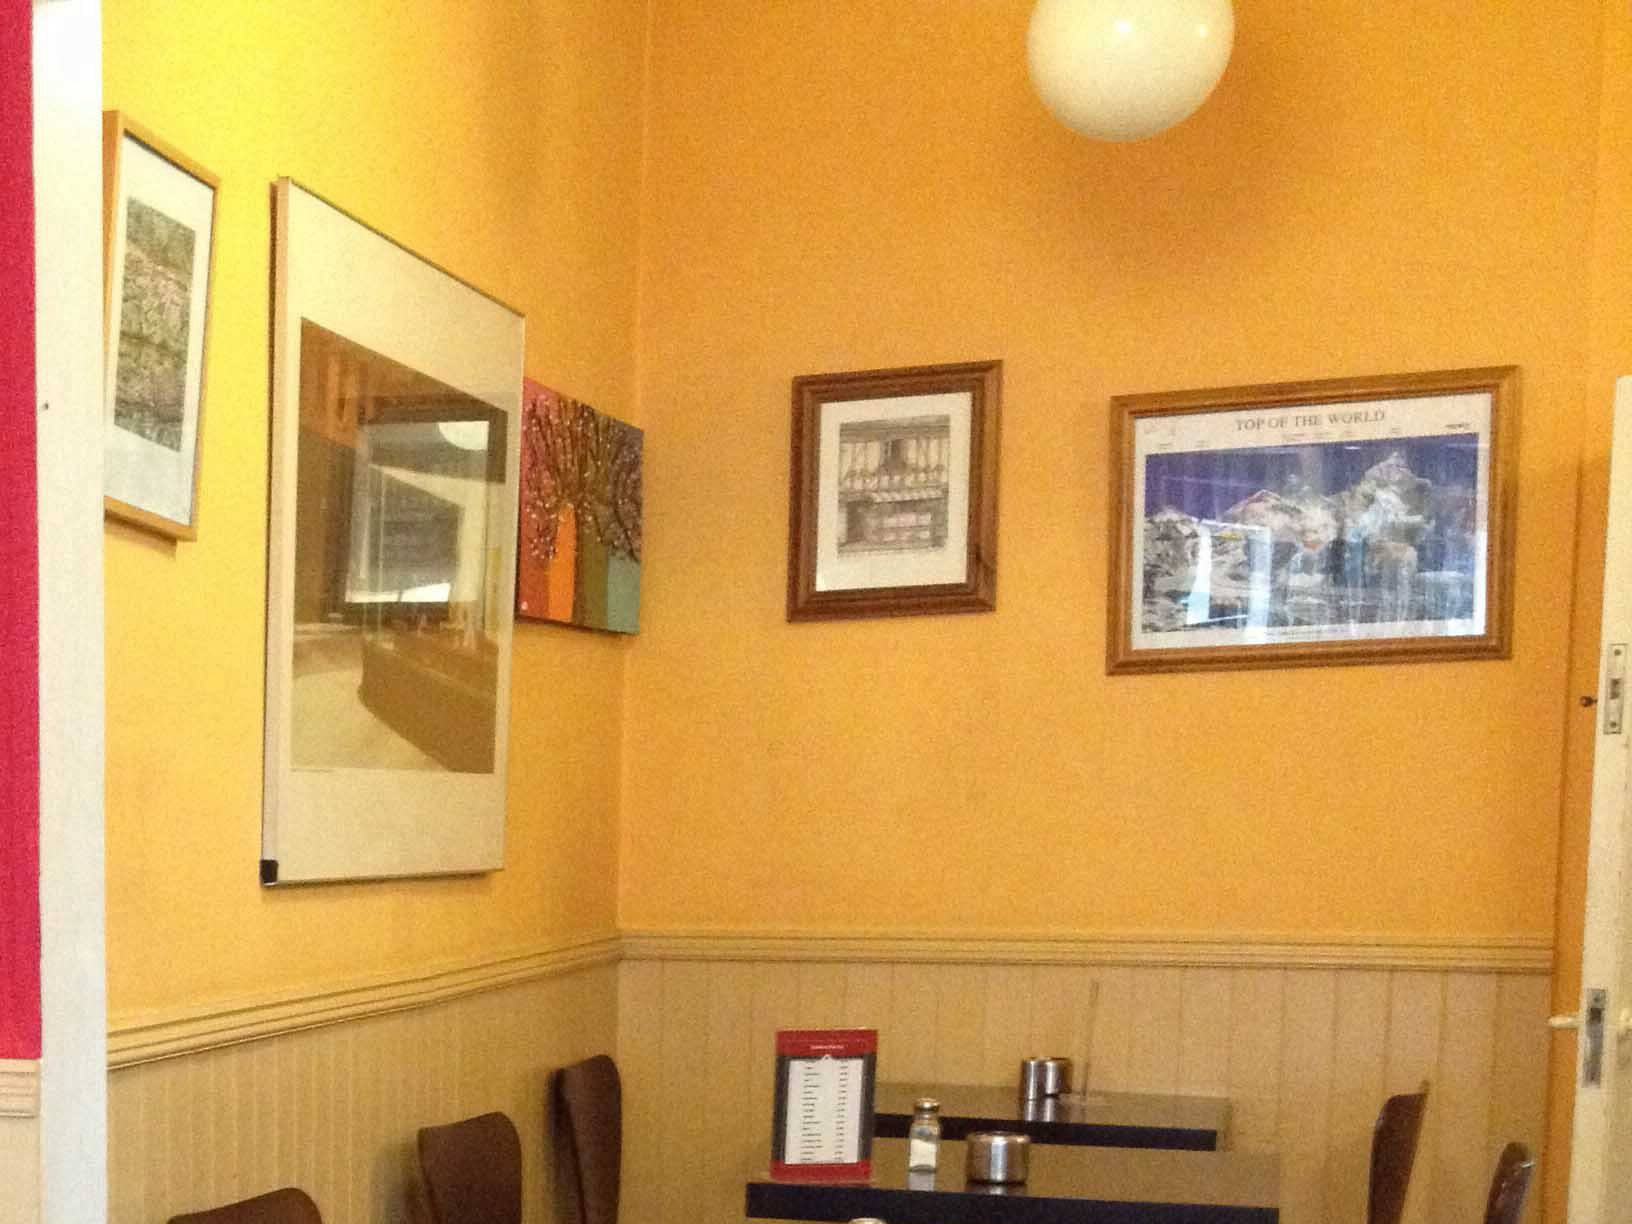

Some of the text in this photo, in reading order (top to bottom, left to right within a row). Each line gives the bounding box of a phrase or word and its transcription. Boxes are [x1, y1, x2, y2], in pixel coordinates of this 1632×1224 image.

[1235, 409, 1386, 433] TOP OF THE WORLD
